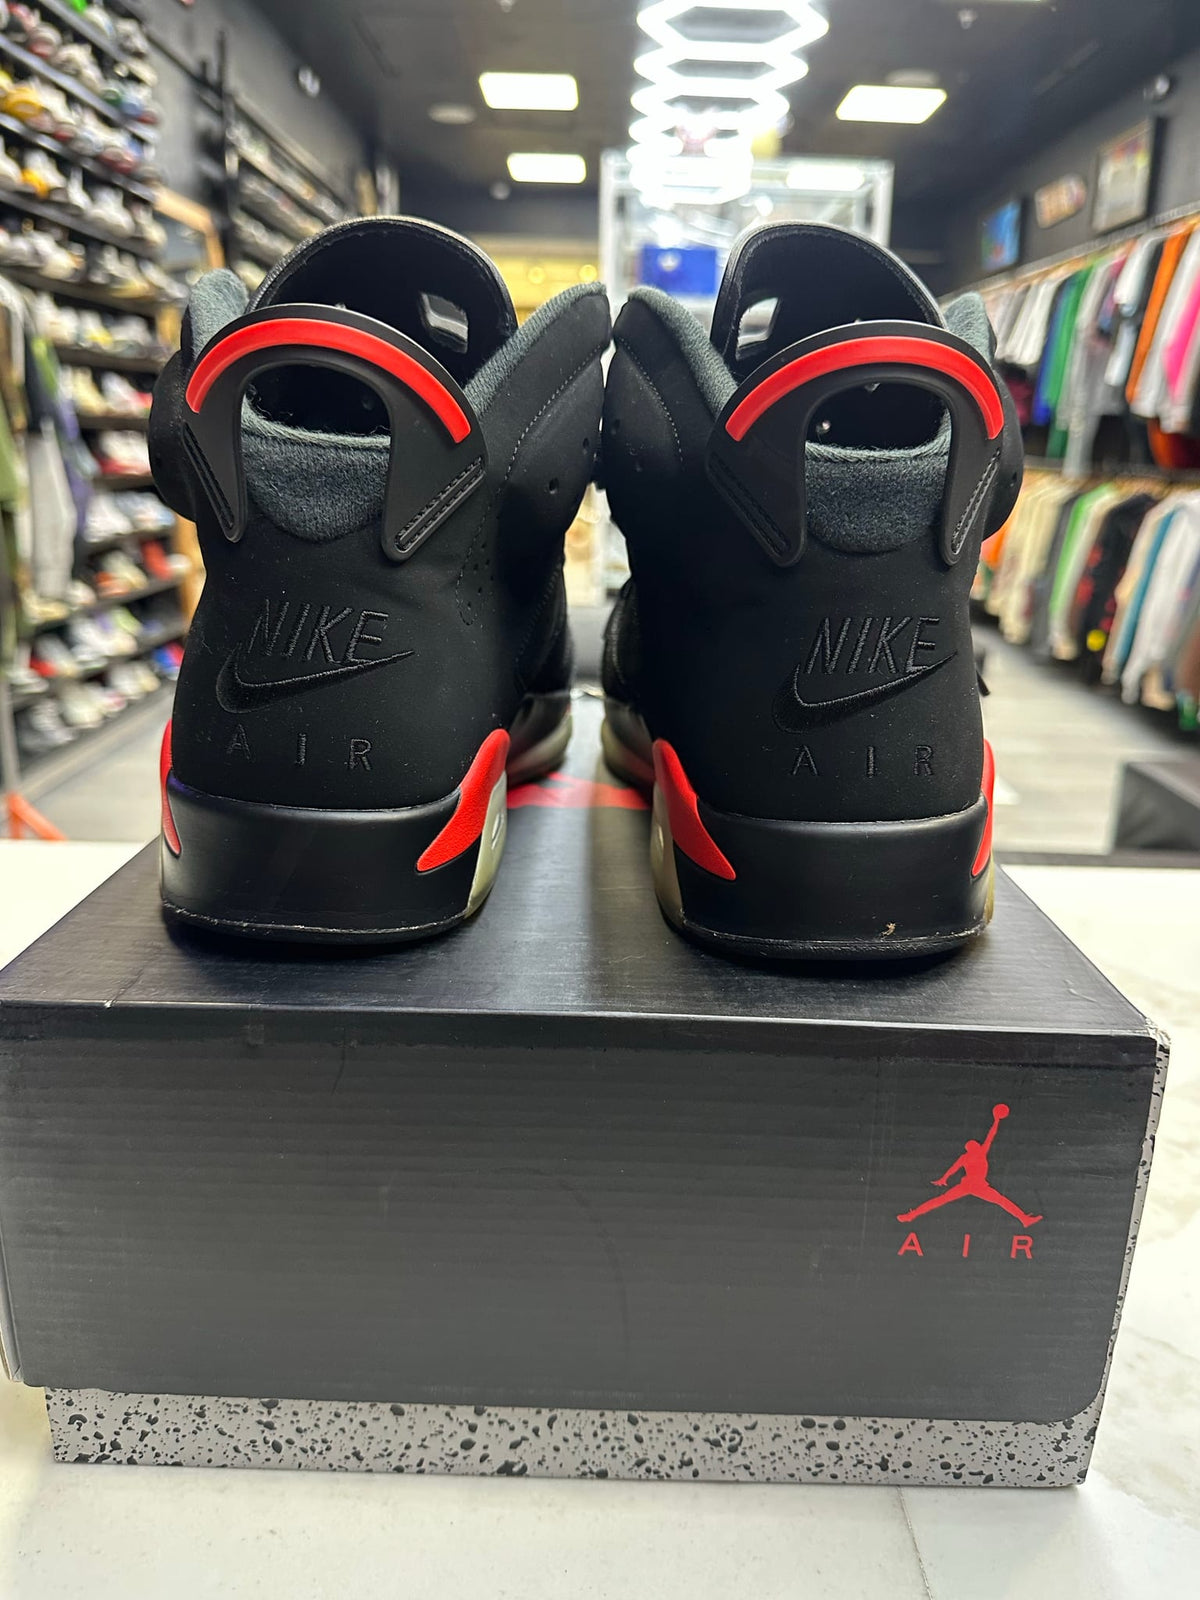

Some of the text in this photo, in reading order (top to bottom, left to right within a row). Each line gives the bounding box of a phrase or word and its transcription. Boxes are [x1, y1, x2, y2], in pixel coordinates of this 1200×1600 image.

[247, 599, 390, 663] NIKE
[805, 616, 941, 674] NIKE
[226, 724, 373, 771] AIR
[790, 744, 935, 777] AIR
[897, 1232, 1034, 1259] AIR
